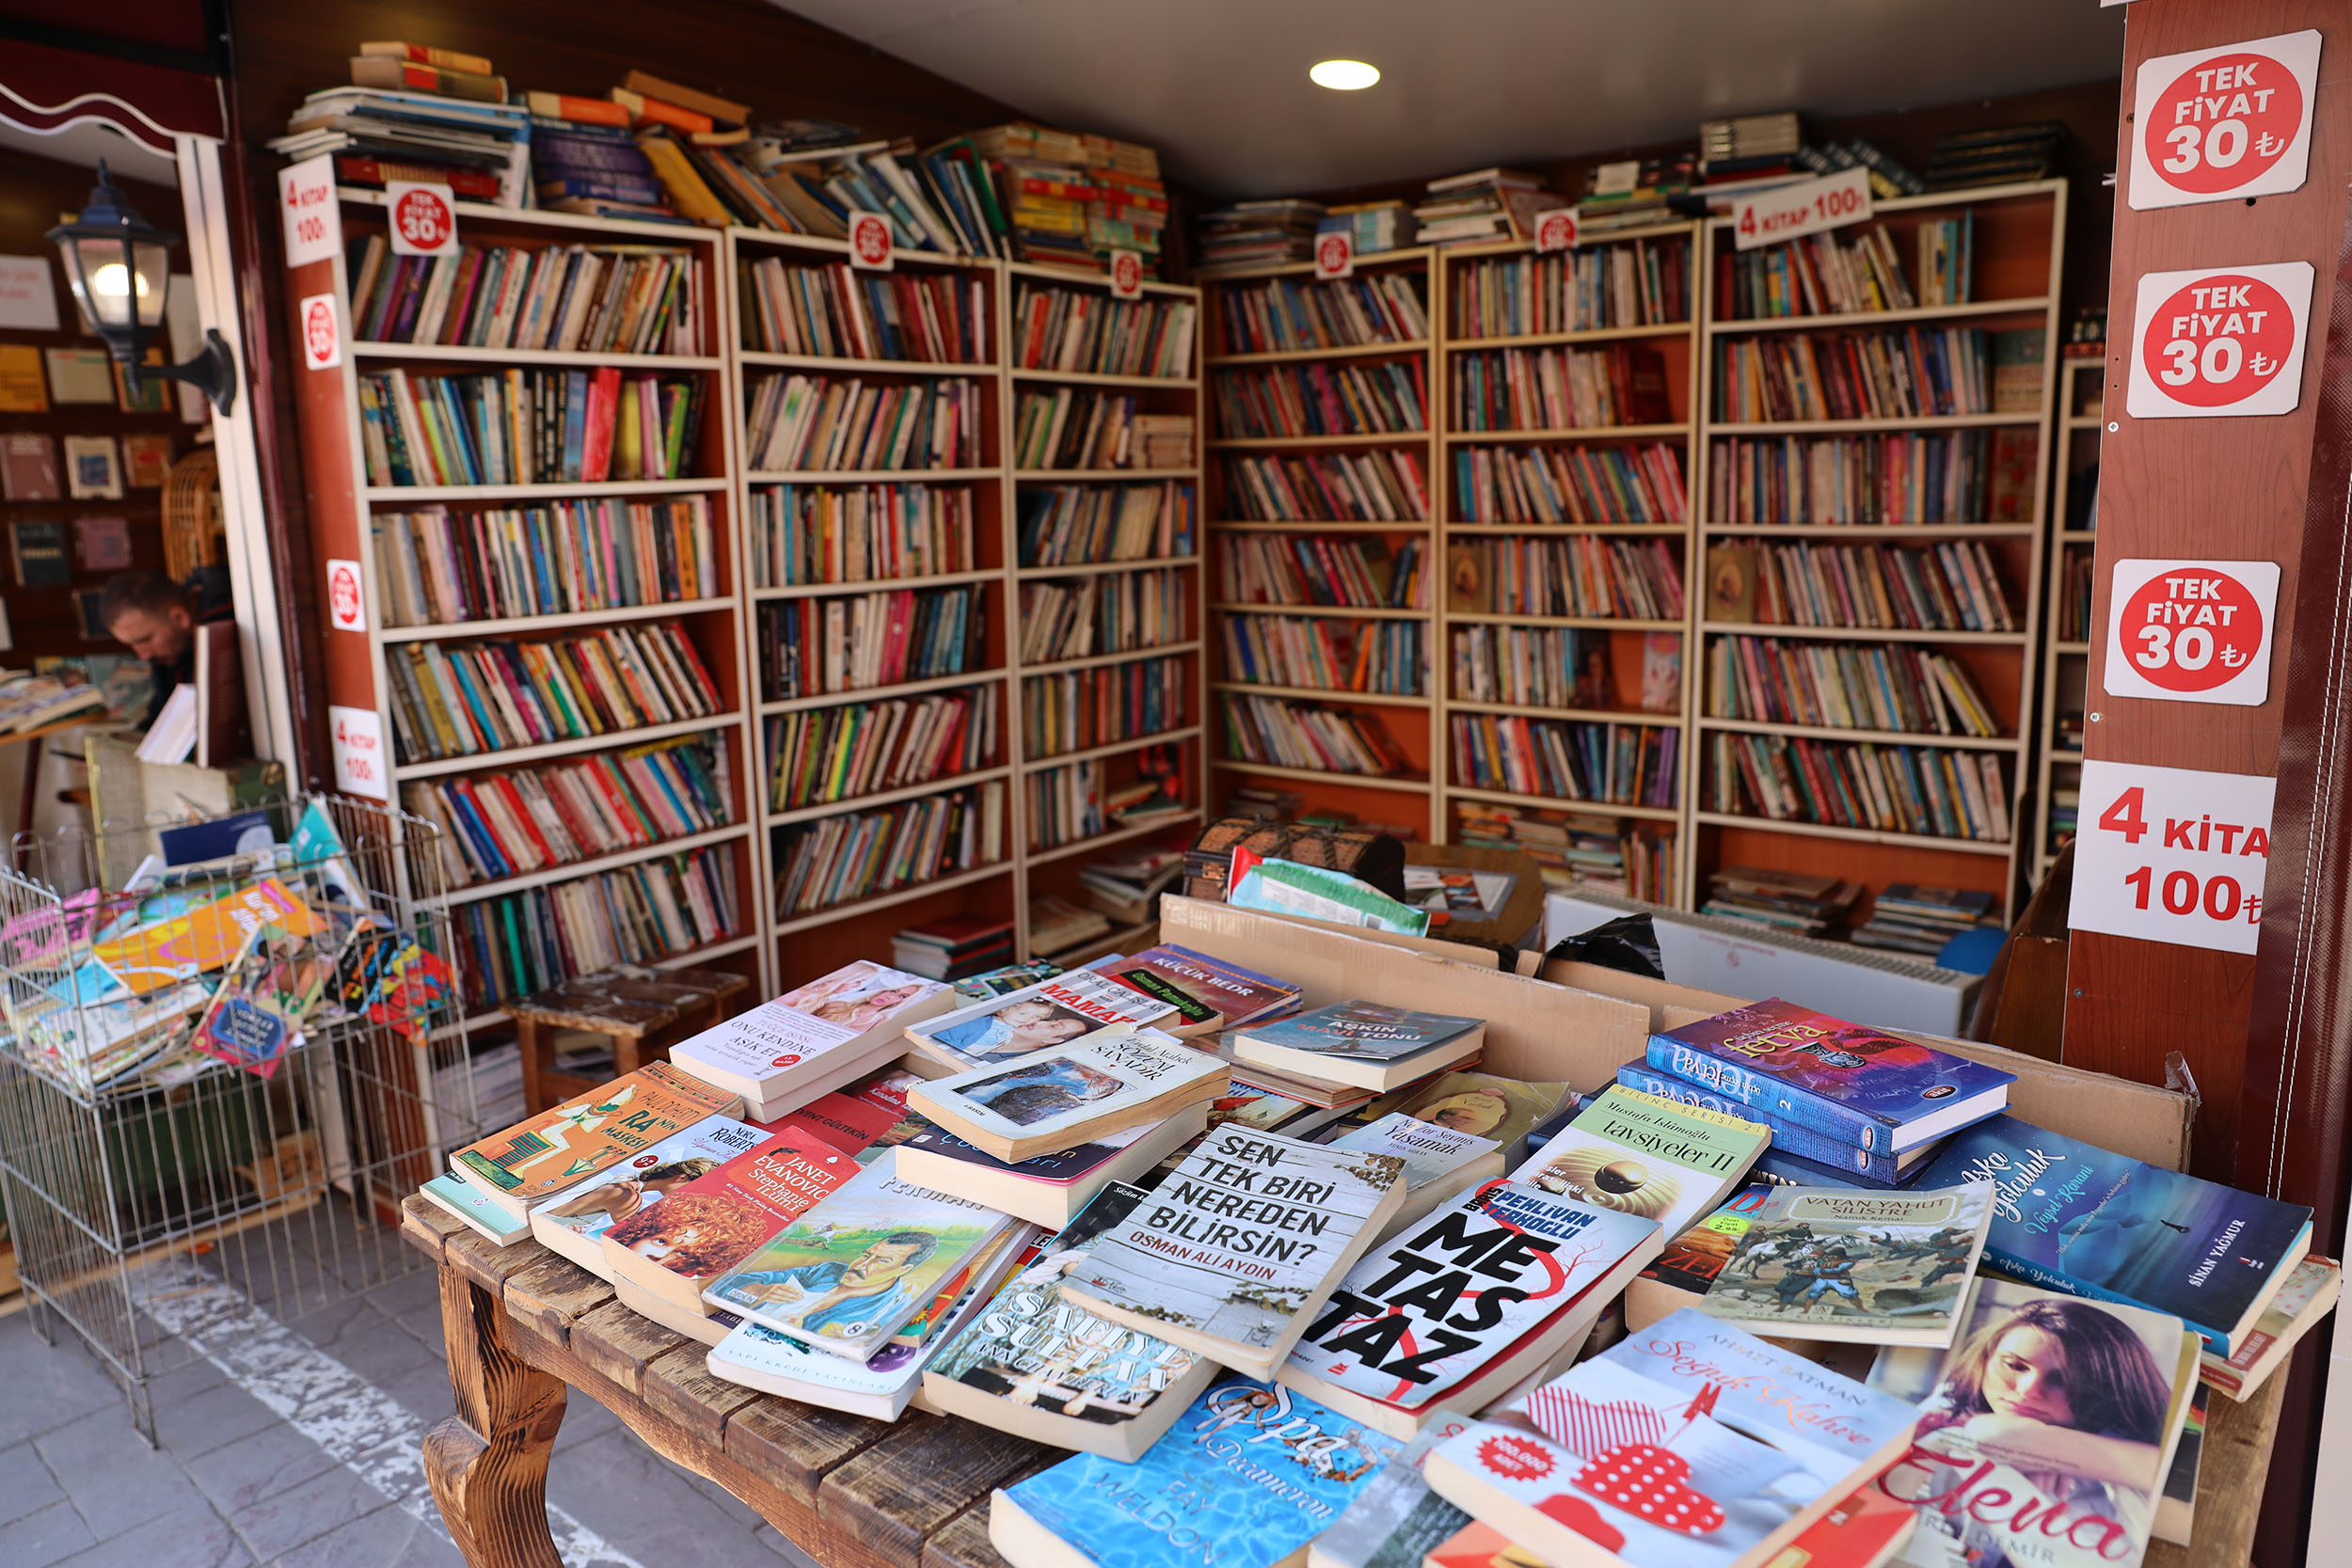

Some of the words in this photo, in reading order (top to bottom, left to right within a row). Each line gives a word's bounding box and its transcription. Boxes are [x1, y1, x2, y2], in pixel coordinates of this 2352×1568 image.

[2195, 62, 2259, 93] TEK
[2163, 119, 2249, 174] 30
[286, 178, 298, 210] 4
[403, 218, 437, 242] 30
[1740, 206, 1757, 238] 4
[2190, 284, 2252, 310] TEK
[2160, 339, 2244, 387] 30
[2165, 578, 2223, 601] TEK
[2136, 625, 2216, 671] 30
[2099, 786, 2149, 845] 4
[1077, 972, 1110, 990] ORAL
[1132, 972, 1162, 992] Osman
[1153, 957, 1212, 985] KÜÇÜK
[731, 1020, 762, 1037] ONU
[1724, 1024, 1828, 1058] fetva
[760, 1047, 782, 1057] ET
[1604, 1101, 1652, 1122] Mustafa
[1680, 1106, 1735, 1129] SERİSİ
[1779, 1099, 1792, 1112] 2
[822, 1116, 871, 1141] GÜLTEKİN
[1602, 1119, 1709, 1164] tavsiyeler
[1708, 1152, 1738, 1172] II
[1216, 1134, 1287, 1167] SEN
[748, 1167, 810, 1208] Stephanie
[784, 1156, 837, 1186] JANET
[1195, 1156, 1260, 1192] TEK
[1262, 1174, 1339, 1207] BİRİ
[1169, 1180, 1331, 1237] NEREDEN
[1805, 1197, 1871, 1208] VATAN
[1875, 1198, 1948, 1210] YAHUT
[2024, 1197, 2063, 1235] Veysel
[2056, 1164, 2094, 1204] Karani
[1145, 1205, 1318, 1267] BİLİRSİN?
[1406, 1211, 1562, 1283] ME
[1129, 1229, 1193, 1261] OSMAN
[1190, 1249, 1226, 1269] ALİ
[1222, 1258, 1278, 1281] AYDIN
[2187, 1258, 2218, 1288] SİNAN
[2209, 1219, 2246, 1258] YAĞMUR
[1361, 1249, 1531, 1332] TAS
[848, 1323, 863, 1334] 8
[1304, 1290, 1483, 1386] TAZ
[1706, 1333, 1776, 1368] AHMET
[1781, 1362, 1869, 1407] BATMAN
[1632, 1338, 1752, 1392] Soğuk
[1756, 1383, 1873, 1447] Kahve
[1203, 1437, 1337, 1520] Decameron
[1157, 1480, 1218, 1515] FAY
[1091, 1471, 1229, 1566] WELDON
